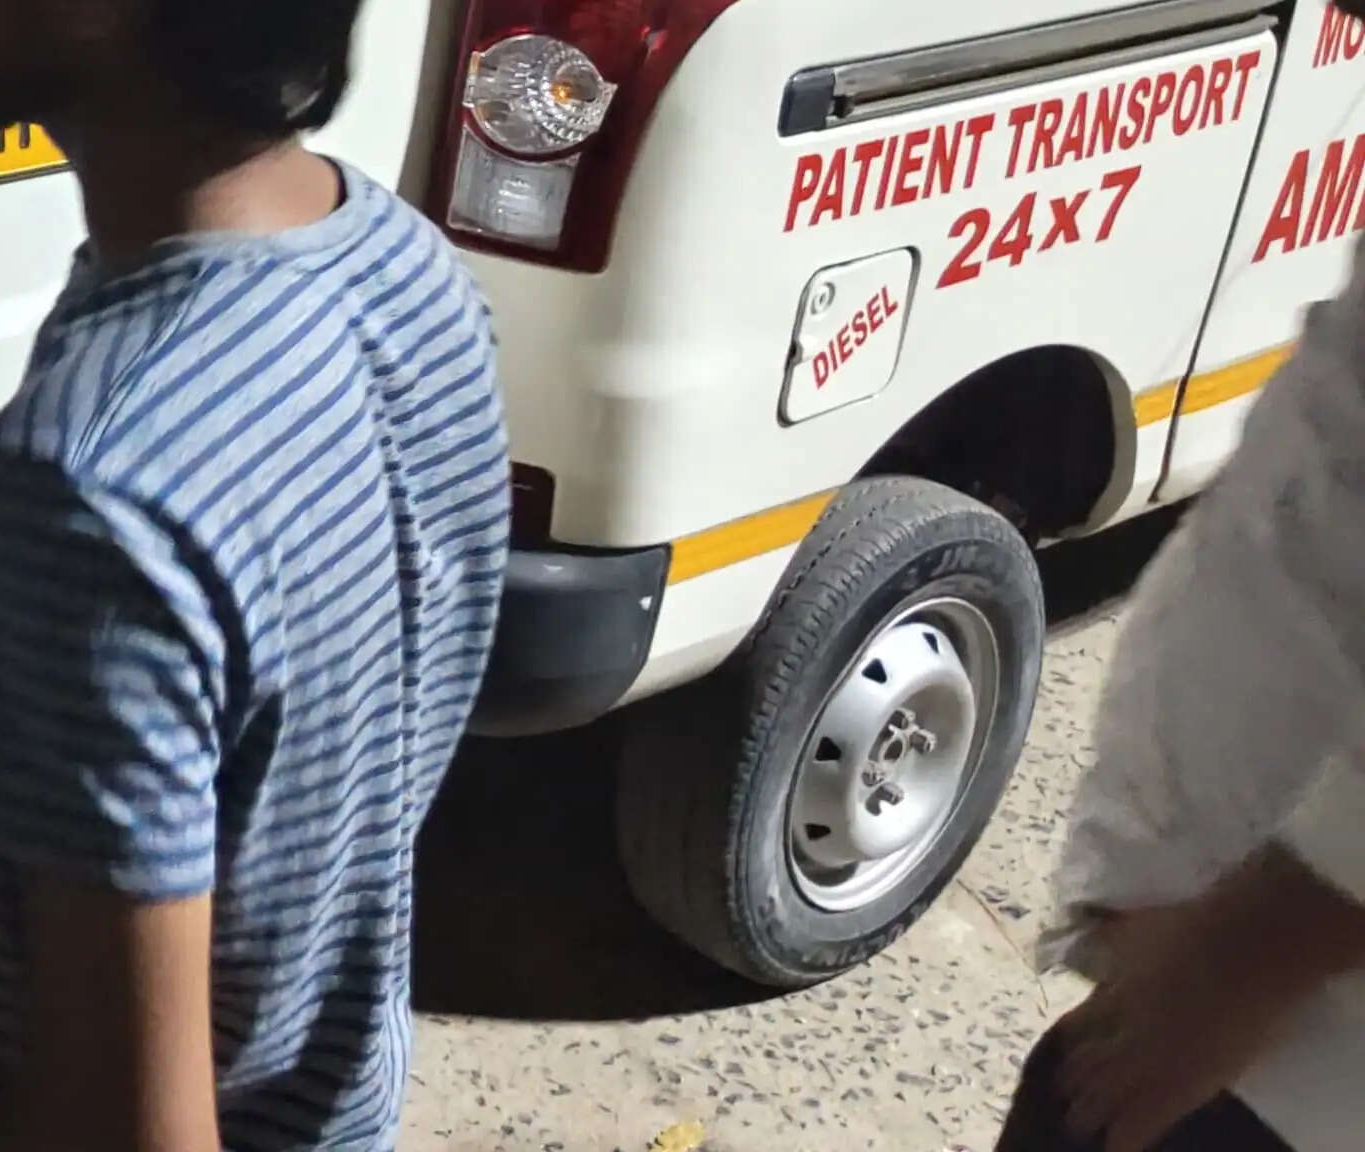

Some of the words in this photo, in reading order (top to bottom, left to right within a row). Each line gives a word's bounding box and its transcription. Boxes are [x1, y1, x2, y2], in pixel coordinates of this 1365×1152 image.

[782, 113, 997, 233] PATIENT
[1004, 50, 1262, 181] TRANSPORT
[1250, 133, 1365, 264] AM
[935, 165, 1143, 290] 24x7
[812, 285, 899, 390] DIESEL
